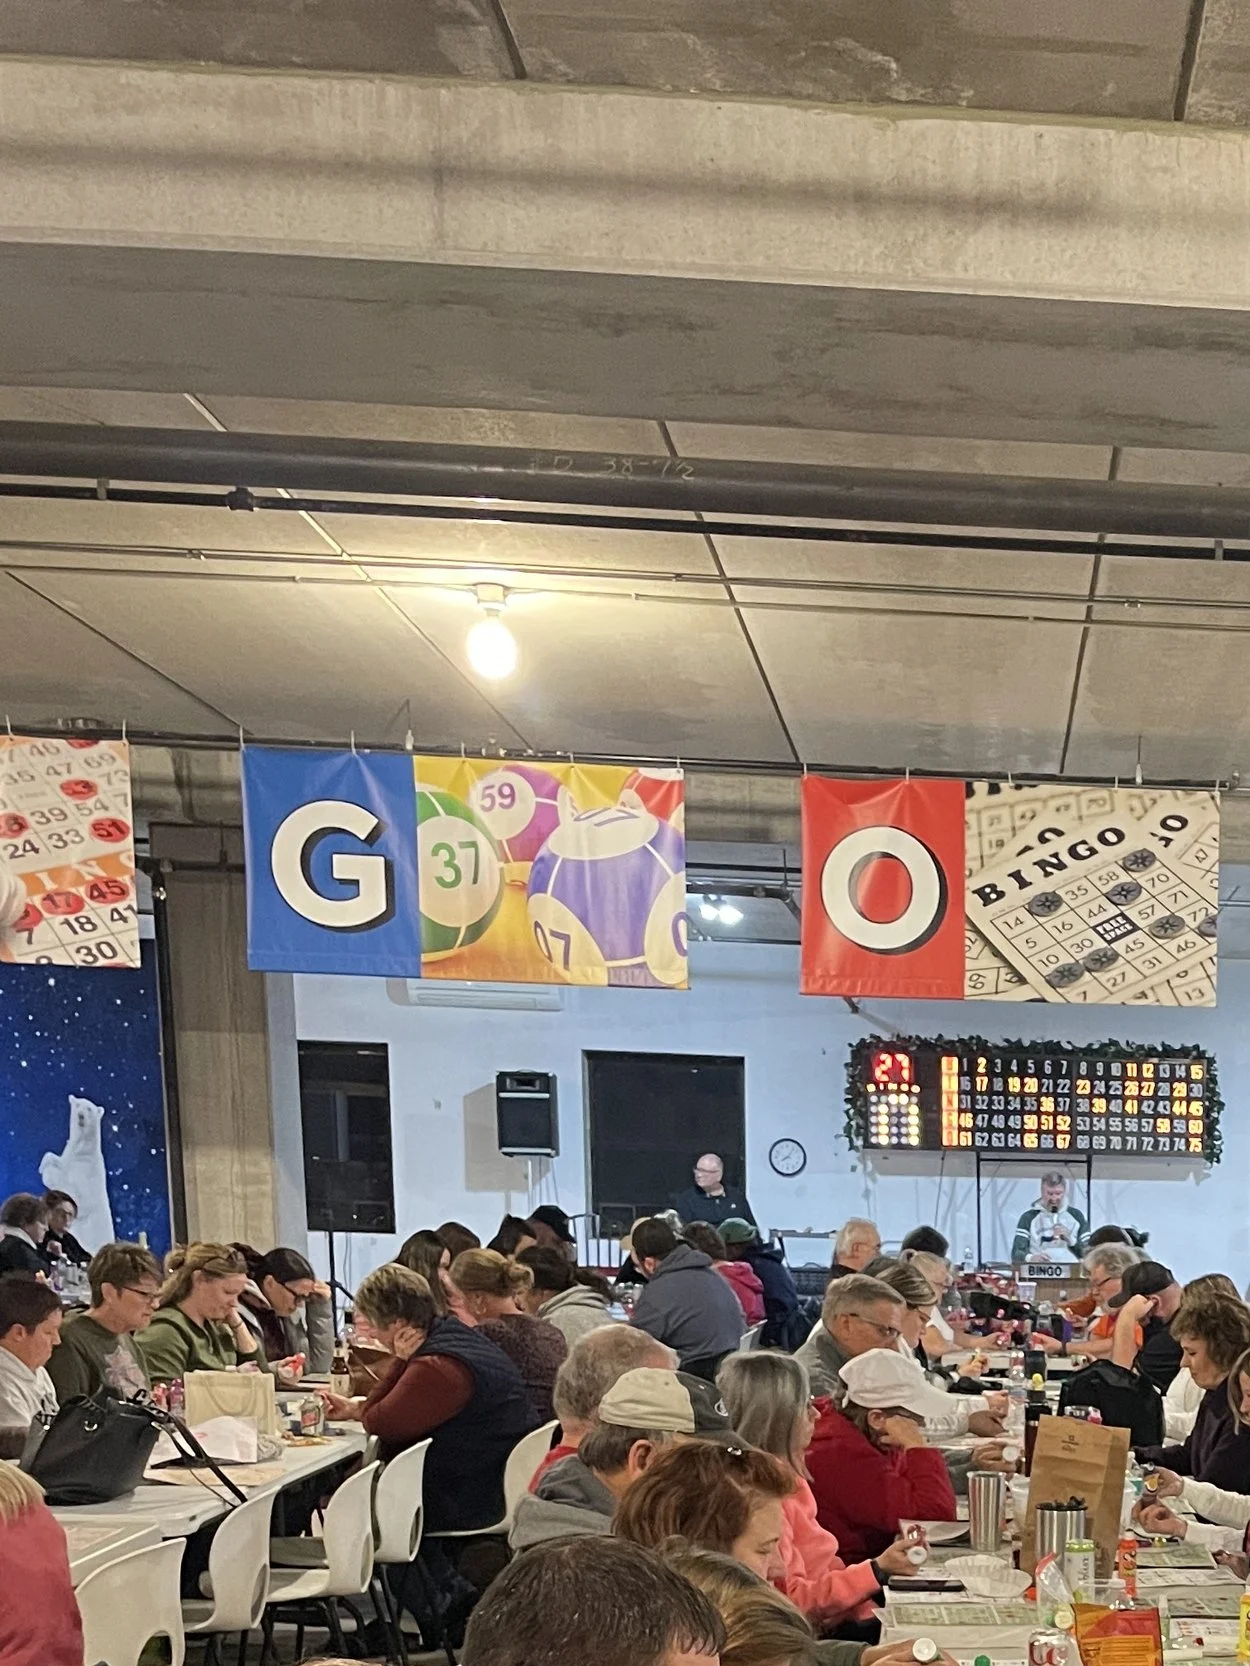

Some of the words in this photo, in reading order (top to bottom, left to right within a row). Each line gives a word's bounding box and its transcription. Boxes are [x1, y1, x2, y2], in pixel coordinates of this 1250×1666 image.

[4, 770, 36, 786] 35
[46, 762, 72, 776] 47
[84, 753, 116, 769] 69
[480, 782, 517, 812] 59
[30, 807, 68, 826] 39
[76, 800, 110, 817] 54
[4, 839, 40, 859] 24
[48, 829, 84, 849] 33
[92, 821, 127, 838] 51
[271, 799, 396, 933] G
[430, 840, 480, 889] 37
[971, 827, 1125, 908] BINGO
[42, 893, 72, 909] 17
[89, 880, 125, 901] 45
[820, 825, 949, 955] O
[1002, 916, 1024, 931] 14
[1065, 884, 1089, 900] 35
[1098, 871, 1120, 886] 58
[1026, 937, 1037, 949] 5
[1052, 921, 1073, 935] 16
[1087, 904, 1107, 919] 44
[1146, 873, 1170, 889] 70
[1095, 913, 1128, 935] FREE
[60, 915, 98, 936] 18
[1038, 954, 1059, 968] 10
[1070, 938, 1094, 954] 30
[1138, 904, 1157, 920] 57
[1167, 890, 1189, 904] 71
[1103, 925, 1134, 942] SPACE
[1124, 939, 1145, 955] 45
[1187, 906, 1210, 923] 72
[75, 941, 118, 965] 30
[1106, 971, 1127, 988] 27
[1142, 956, 1162, 970] 31
[1176, 939, 1196, 954] 46
[875, 1053, 909, 1082] 27
[962, 1058, 968, 1072] 1
[978, 1057, 986, 1073] 2
[995, 1059, 1001, 1072] 3
[1011, 1060, 1017, 1072] 4
[1028, 1060, 1034, 1073] 5
[1045, 1060, 1051, 1074] 6
[1061, 1060, 1067, 1074] 7
[1080, 1062, 1087, 1075] 8
[1096, 1062, 1103, 1075] 9
[1127, 1063, 1137, 1077] 11
[1143, 1063, 1154, 1077] 12
[1175, 1064, 1186, 1078] 14
[1191, 1065, 1203, 1079] 15
[976, 1077, 988, 1091] 17
[1008, 1077, 1020, 1092] 19
[1024, 1078, 1038, 1093] 20
[1042, 1079, 1053, 1092] 21
[1057, 1079, 1070, 1093] 22
[1094, 1081, 1105, 1094] 24
[1109, 1081, 1122, 1095] 25
[1124, 1081, 1138, 1095] 26
[1141, 1082, 1155, 1096] 27
[959, 1095, 971, 1109] 31
[975, 1095, 988, 1109] 32
[992, 1096, 1004, 1110] 33
[1008, 1097, 1020, 1110] 34
[1057, 1098, 1070, 1111] 37
[1092, 1098, 1106, 1113] 39
[1125, 1100, 1137, 1114] 41
[1141, 1100, 1154, 1114] 42
[1157, 1101, 1170, 1114] 43
[1172, 1100, 1187, 1115] 44
[957, 1113, 973, 1128] 46
[975, 1114, 988, 1127] 47
[1008, 1115, 1021, 1129] 49
[1041, 1115, 1053, 1130] 51
[1057, 1115, 1070, 1130] 52
[1077, 1117, 1090, 1130] 53
[1093, 1117, 1106, 1131] 54
[1109, 1117, 1122, 1131] 55
[1124, 1118, 1138, 1132] 56
[1141, 1118, 1154, 1132] 57
[1157, 1118, 1170, 1133] 58
[959, 1132, 972, 1146] 61
[975, 1132, 989, 1146] 62
[992, 1133, 1005, 1147] 63
[1008, 1133, 1021, 1147] 64
[1057, 1134, 1070, 1148] 67
[1092, 1136, 1106, 1149] 69
[1109, 1136, 1122, 1150] 70
[1125, 1136, 1137, 1150] 71
[1140, 1137, 1154, 1152] 72
[1157, 1137, 1171, 1152] 73
[1173, 1138, 1186, 1152] 74
[1189, 1138, 1202, 1152] 75
[1028, 1265, 1062, 1276] BINGO
